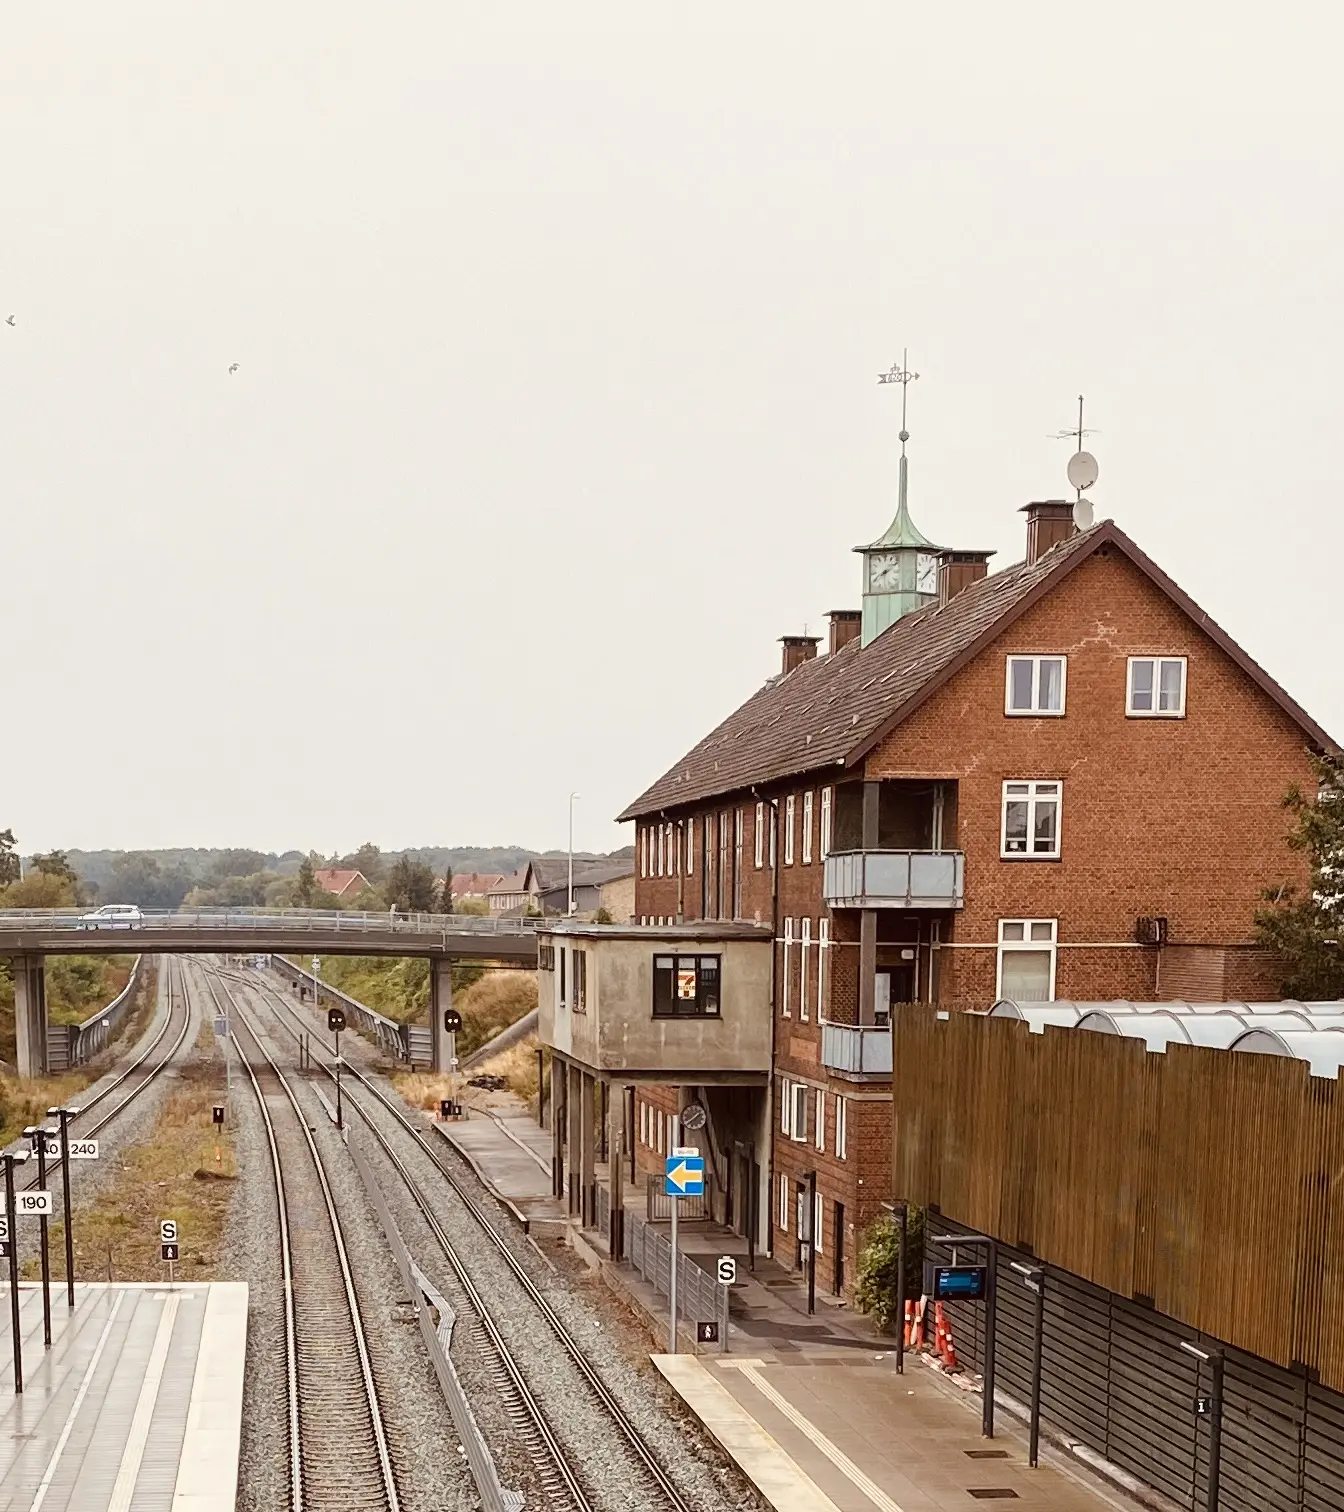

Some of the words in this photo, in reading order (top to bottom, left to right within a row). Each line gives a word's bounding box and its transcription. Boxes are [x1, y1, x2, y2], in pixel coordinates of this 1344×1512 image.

[70, 1143, 96, 1155] 240
[21, 1196, 47, 1210] 190
[162, 1222, 175, 1239] S
[718, 1261, 735, 1281] S
[1197, 1402, 1205, 1413] 1
